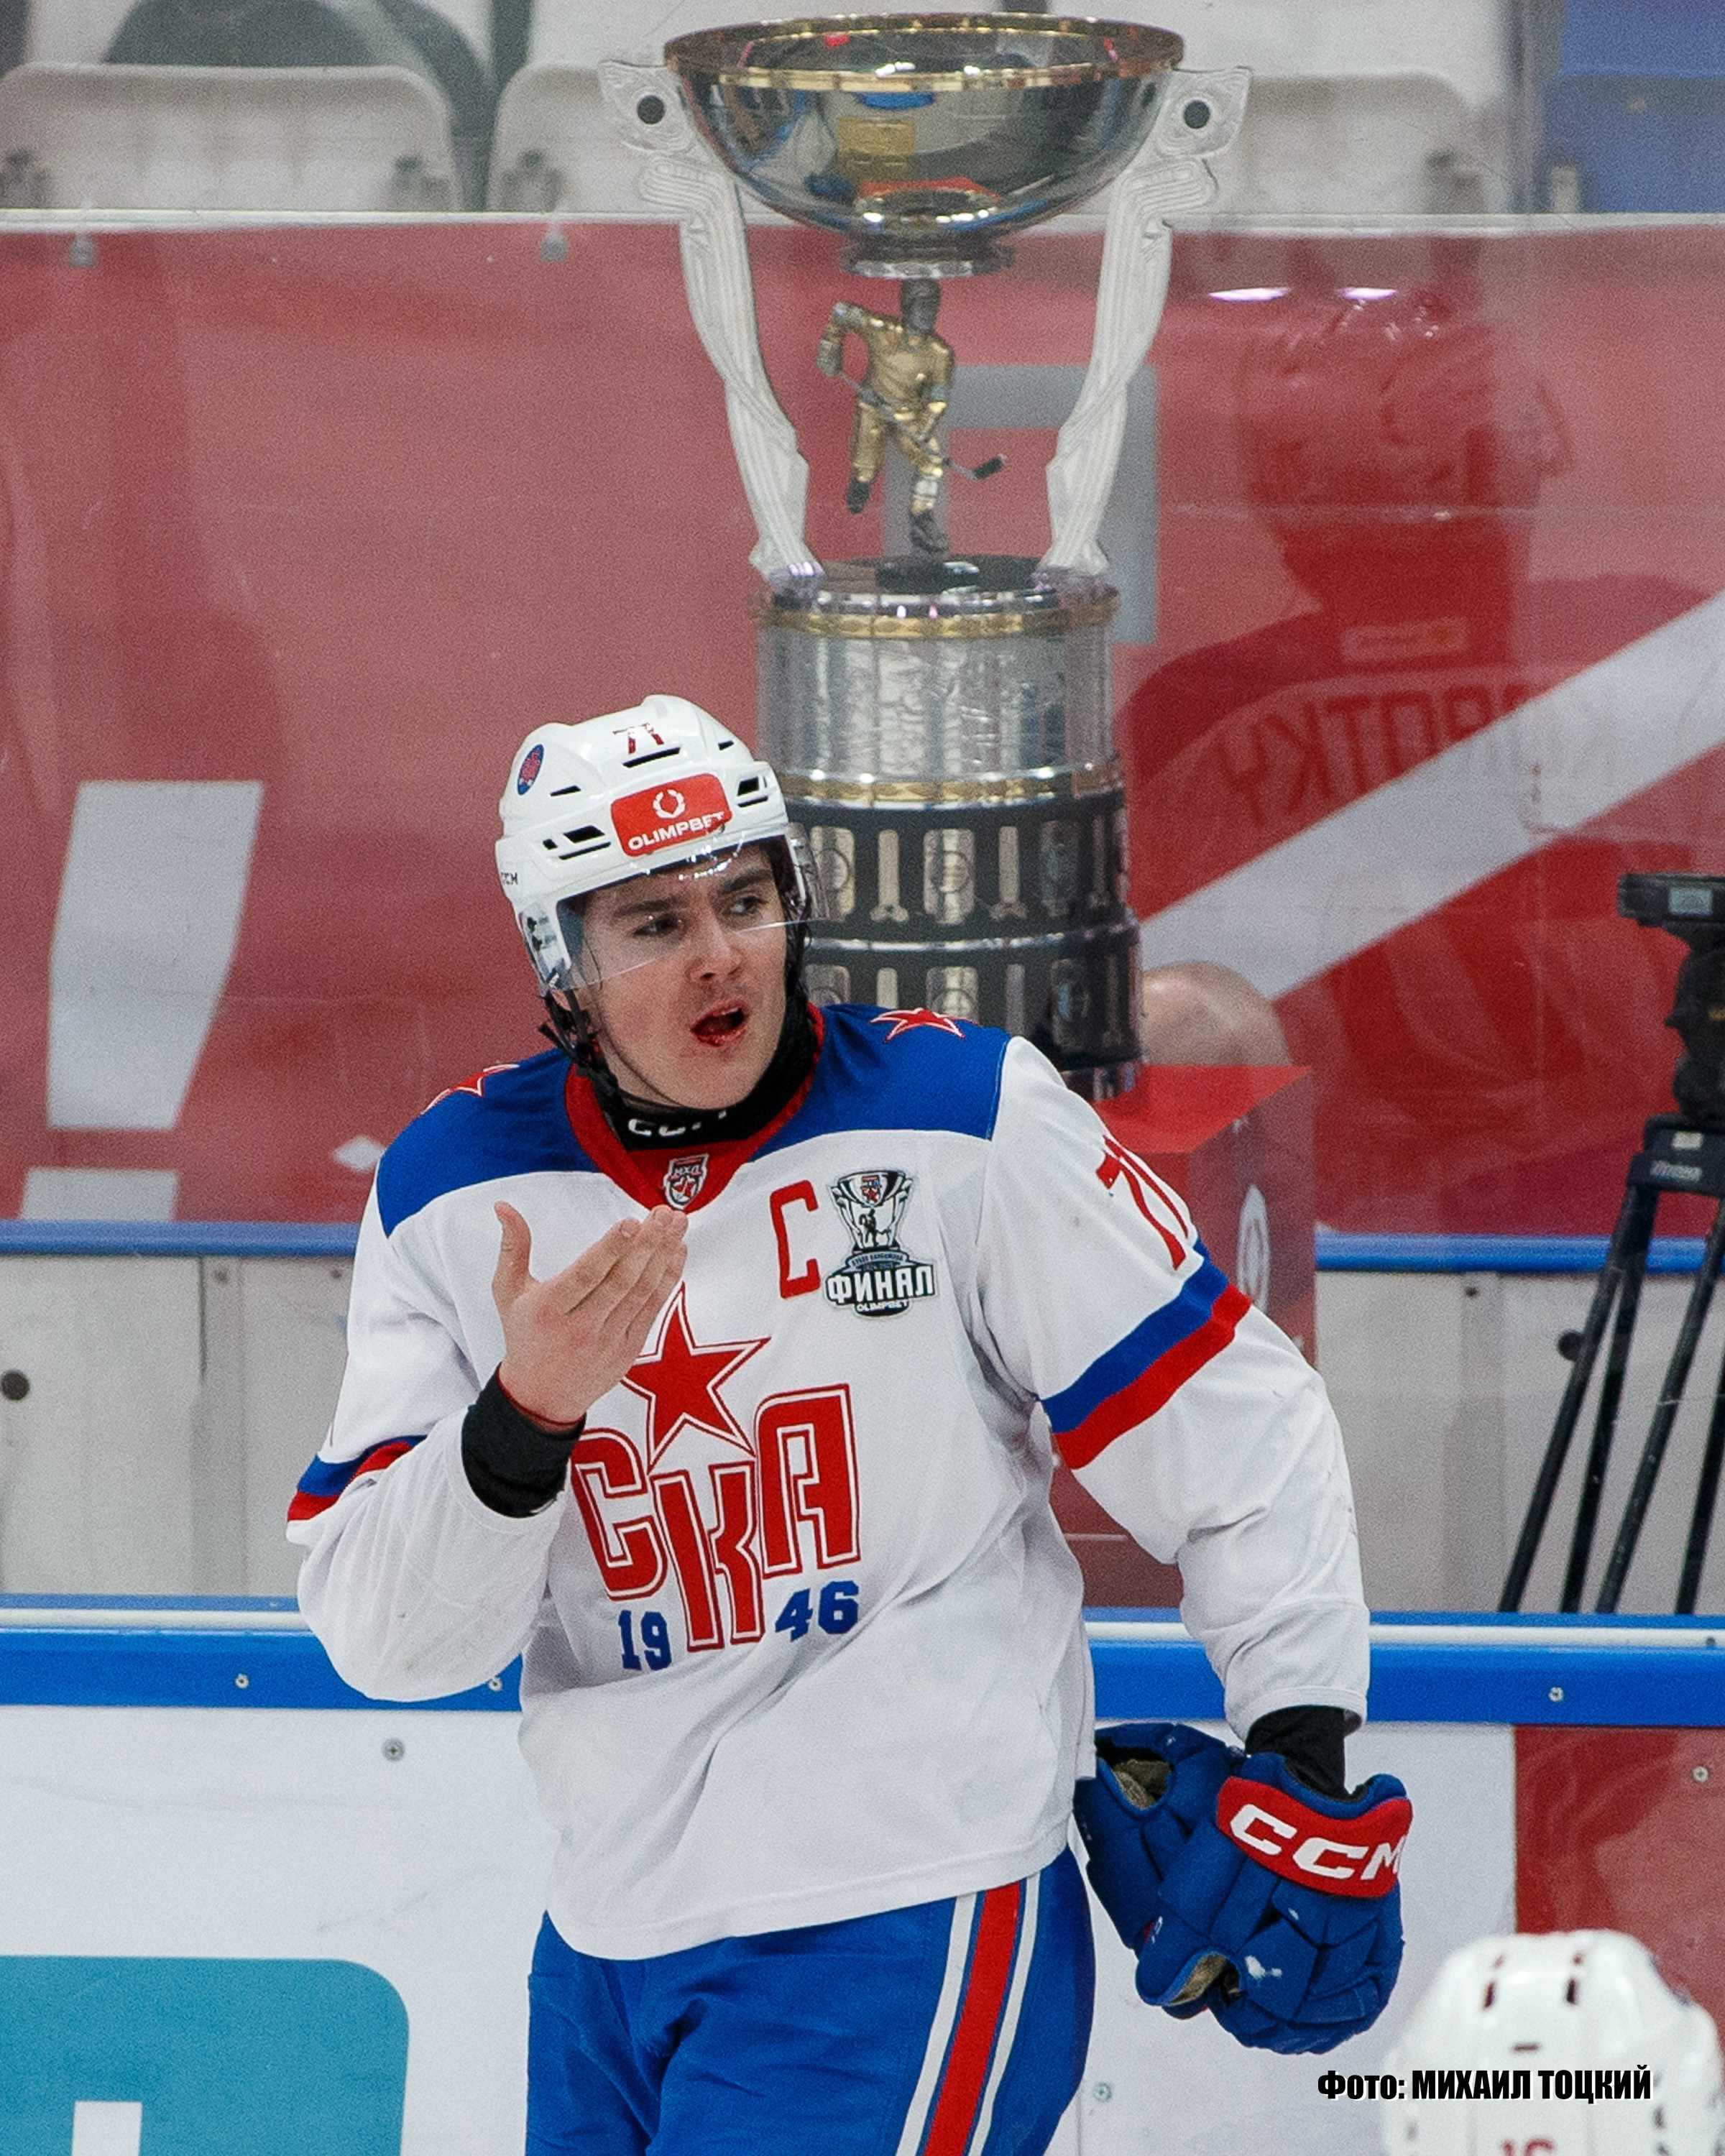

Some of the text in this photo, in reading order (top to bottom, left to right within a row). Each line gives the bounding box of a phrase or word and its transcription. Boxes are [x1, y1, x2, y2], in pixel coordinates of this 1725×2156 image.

[627, 811, 725, 851] OLIMPBET
[827, 1266, 934, 1304] ФИНАЛ
[570, 1383, 861, 1653] СКА
[1229, 1803, 1407, 1881] CCM
